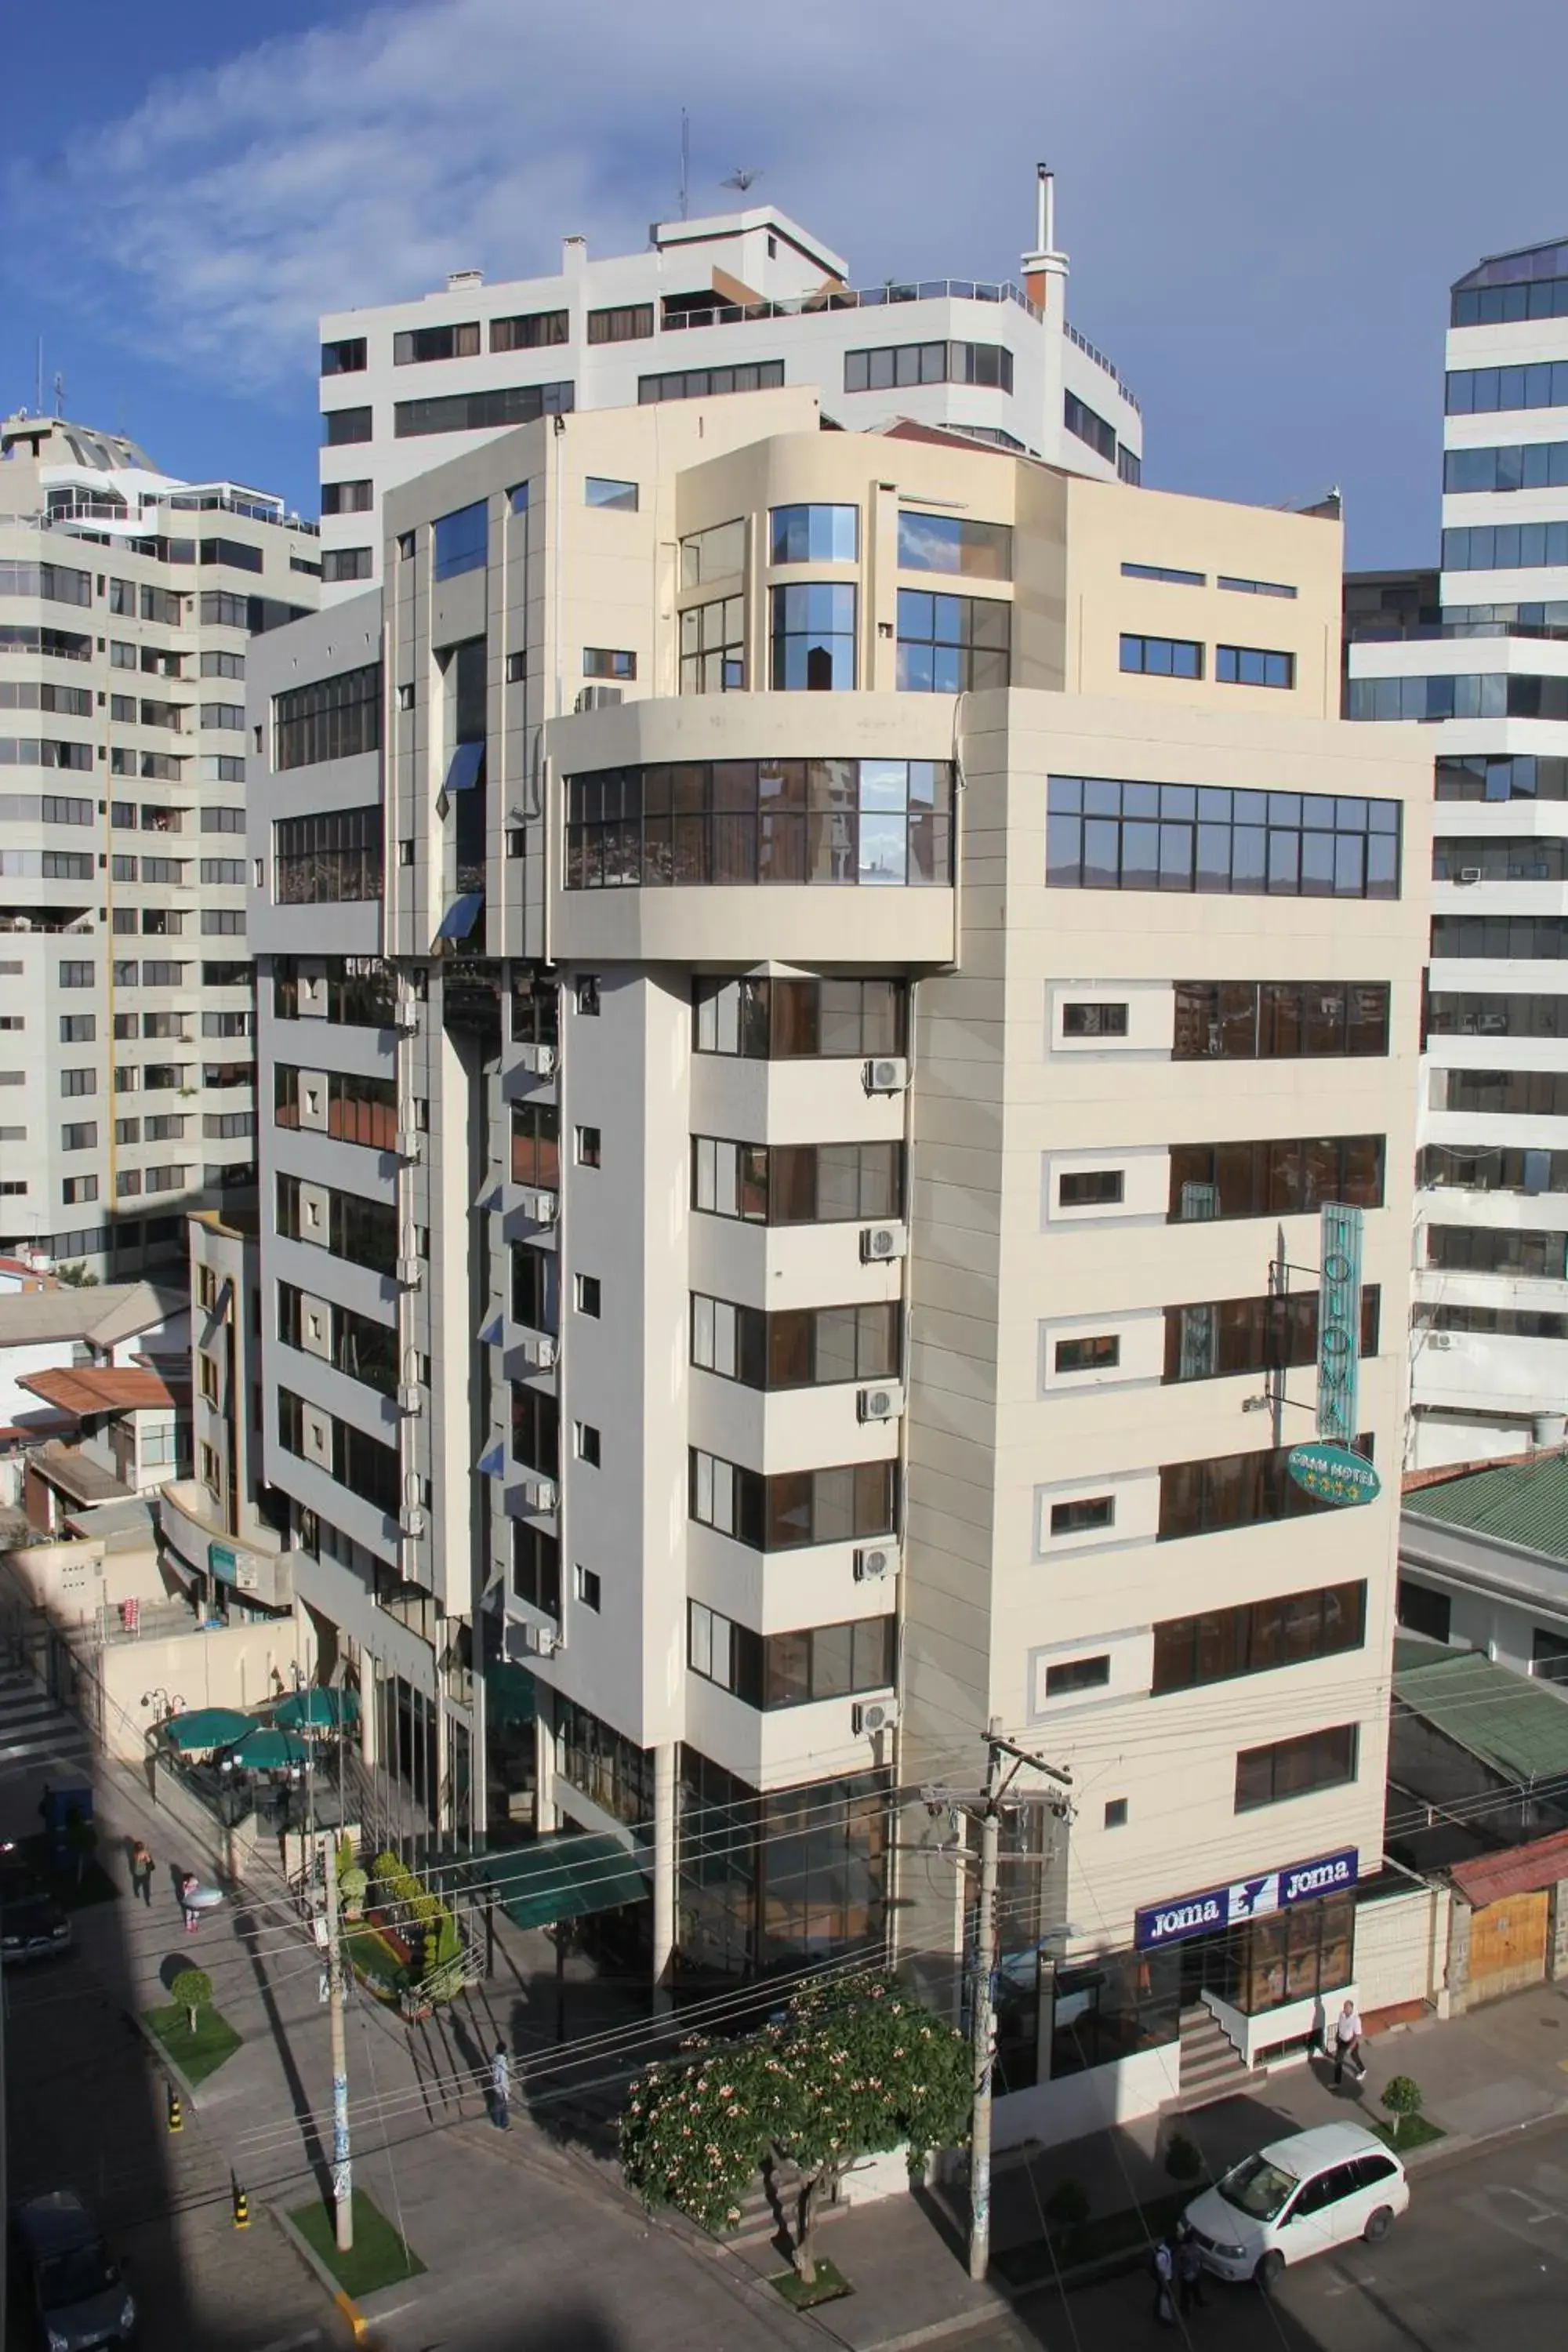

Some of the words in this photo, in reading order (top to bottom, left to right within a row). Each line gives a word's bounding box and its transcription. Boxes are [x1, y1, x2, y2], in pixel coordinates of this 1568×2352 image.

[1289, 1452, 1328, 1473] GRAN
[1330, 1462, 1375, 1486] HOTEL
[1151, 1900, 1220, 1938] Joma
[1287, 1860, 1349, 1899] Joma
